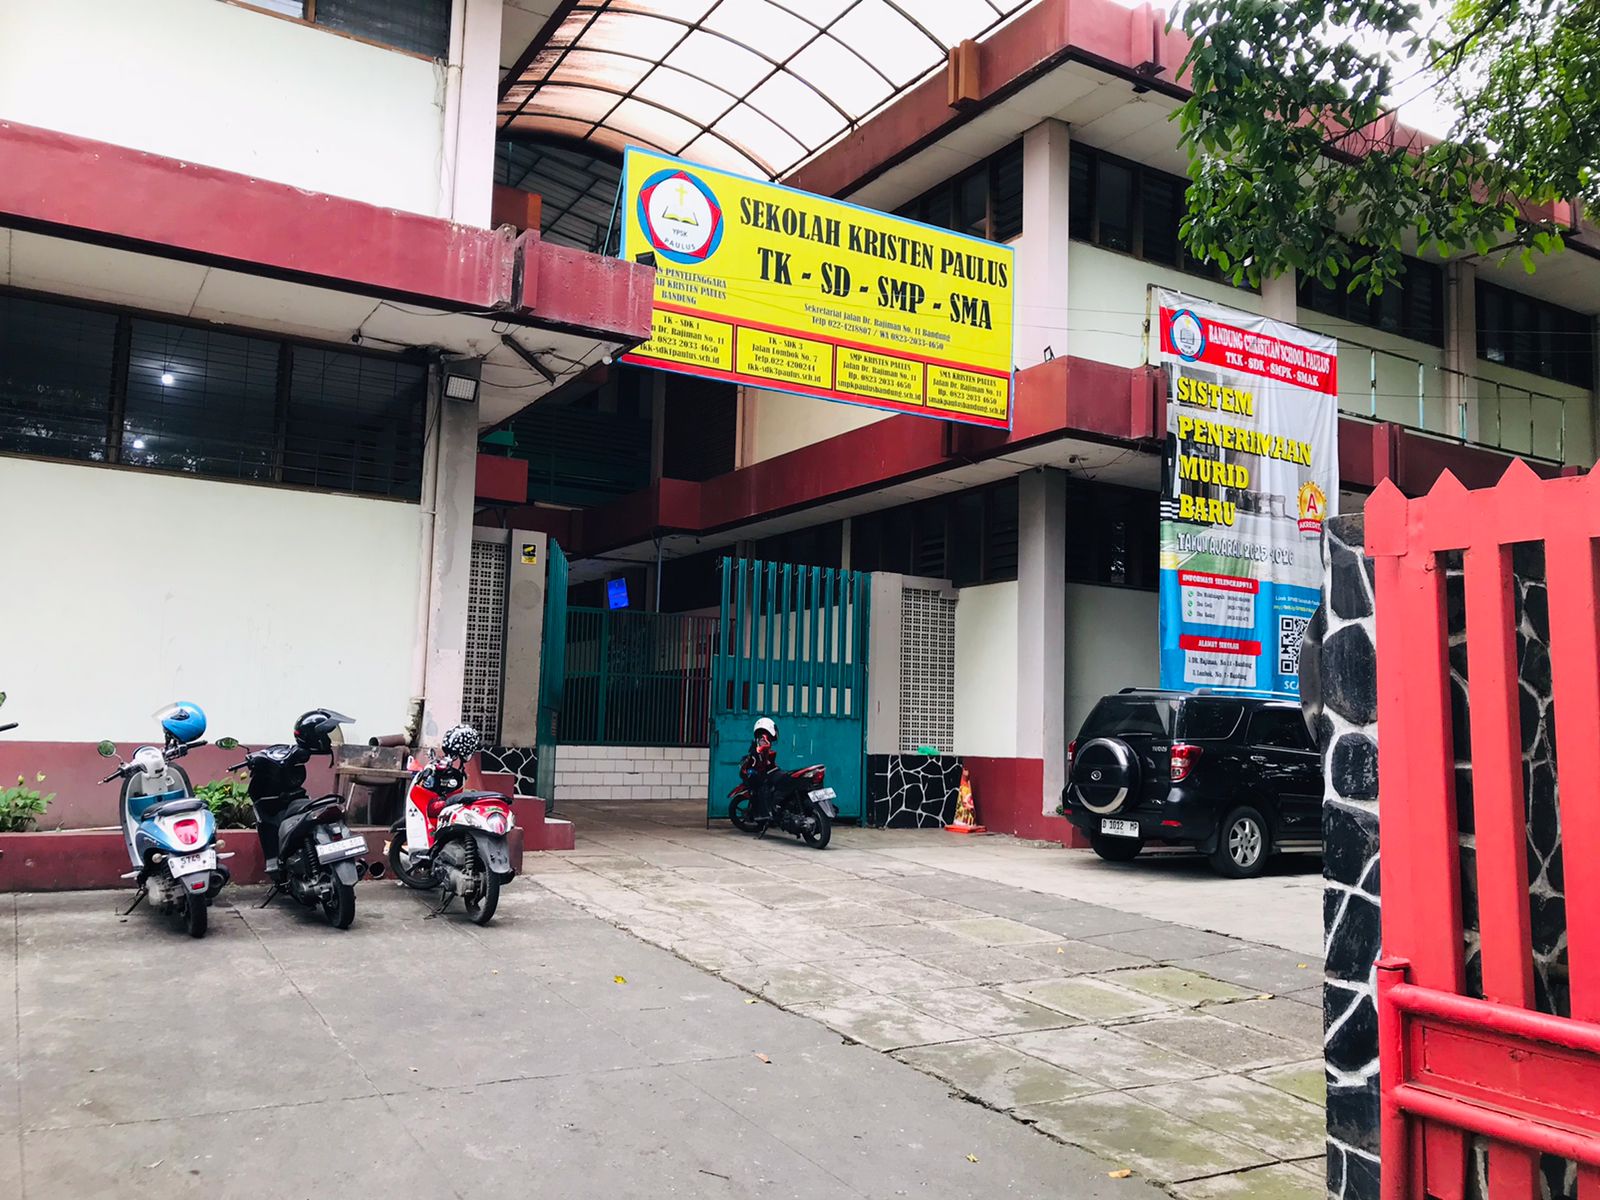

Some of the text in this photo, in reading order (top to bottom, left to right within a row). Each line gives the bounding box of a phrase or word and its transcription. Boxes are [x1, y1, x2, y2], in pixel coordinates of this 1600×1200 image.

[672, 228, 689, 238] YPSK
[740, 196, 1008, 289] SEKOLAH KRISTEN PAULUS
[664, 237, 697, 251] PAULUS
[665, 267, 727, 289] PENYELENGGARA
[757, 247, 792, 285] TK
[821, 262, 850, 298] SD
[877, 275, 925, 314] SMP
[950, 292, 993, 330] SMA
[661, 290, 697, 305] BANDUNG
[667, 280, 699, 294] KRISTEN
[700, 287, 727, 300] PAULUS
[663, 315, 673, 325] TK
[680, 318, 694, 329] SDK
[804, 303, 951, 342] Sekretariat Jalan Dr. Rajiman No. 11 Bandung
[812, 316, 826, 327] Telp
[879, 330, 889, 339] WA
[657, 335, 677, 346] 0823
[680, 339, 698, 350] 2033
[701, 343, 719, 354] 4650
[658, 325, 670, 334] Dr.
[671, 327, 703, 340] Rajiman
[703, 331, 716, 343] No.
[768, 337, 777, 345] TK
[784, 340, 797, 349] SDK
[752, 343, 771, 354] Jalan
[772, 347, 799, 359] Lombok
[1208, 324, 1330, 374] BANDUNG CHRISTIAN SCHOOL PAULUS
[843, 361, 860, 371] Jalan
[872, 367, 898, 378] Rajiman
[849, 352, 912, 371] SMP KRISTEN PAULUS
[1225, 352, 1244, 366] TKK
[1247, 358, 1266, 373] SDK
[1270, 362, 1293, 380] SMPK
[1296, 371, 1319, 387] SMAK
[1177, 376, 1254, 417] SISTEM
[1177, 415, 1312, 467] PENERIMAAN
[1178, 454, 1249, 490] MURID
[1178, 493, 1236, 527] BARU
[1306, 493, 1318, 514] A
[1177, 532, 1208, 554] TAHUN
